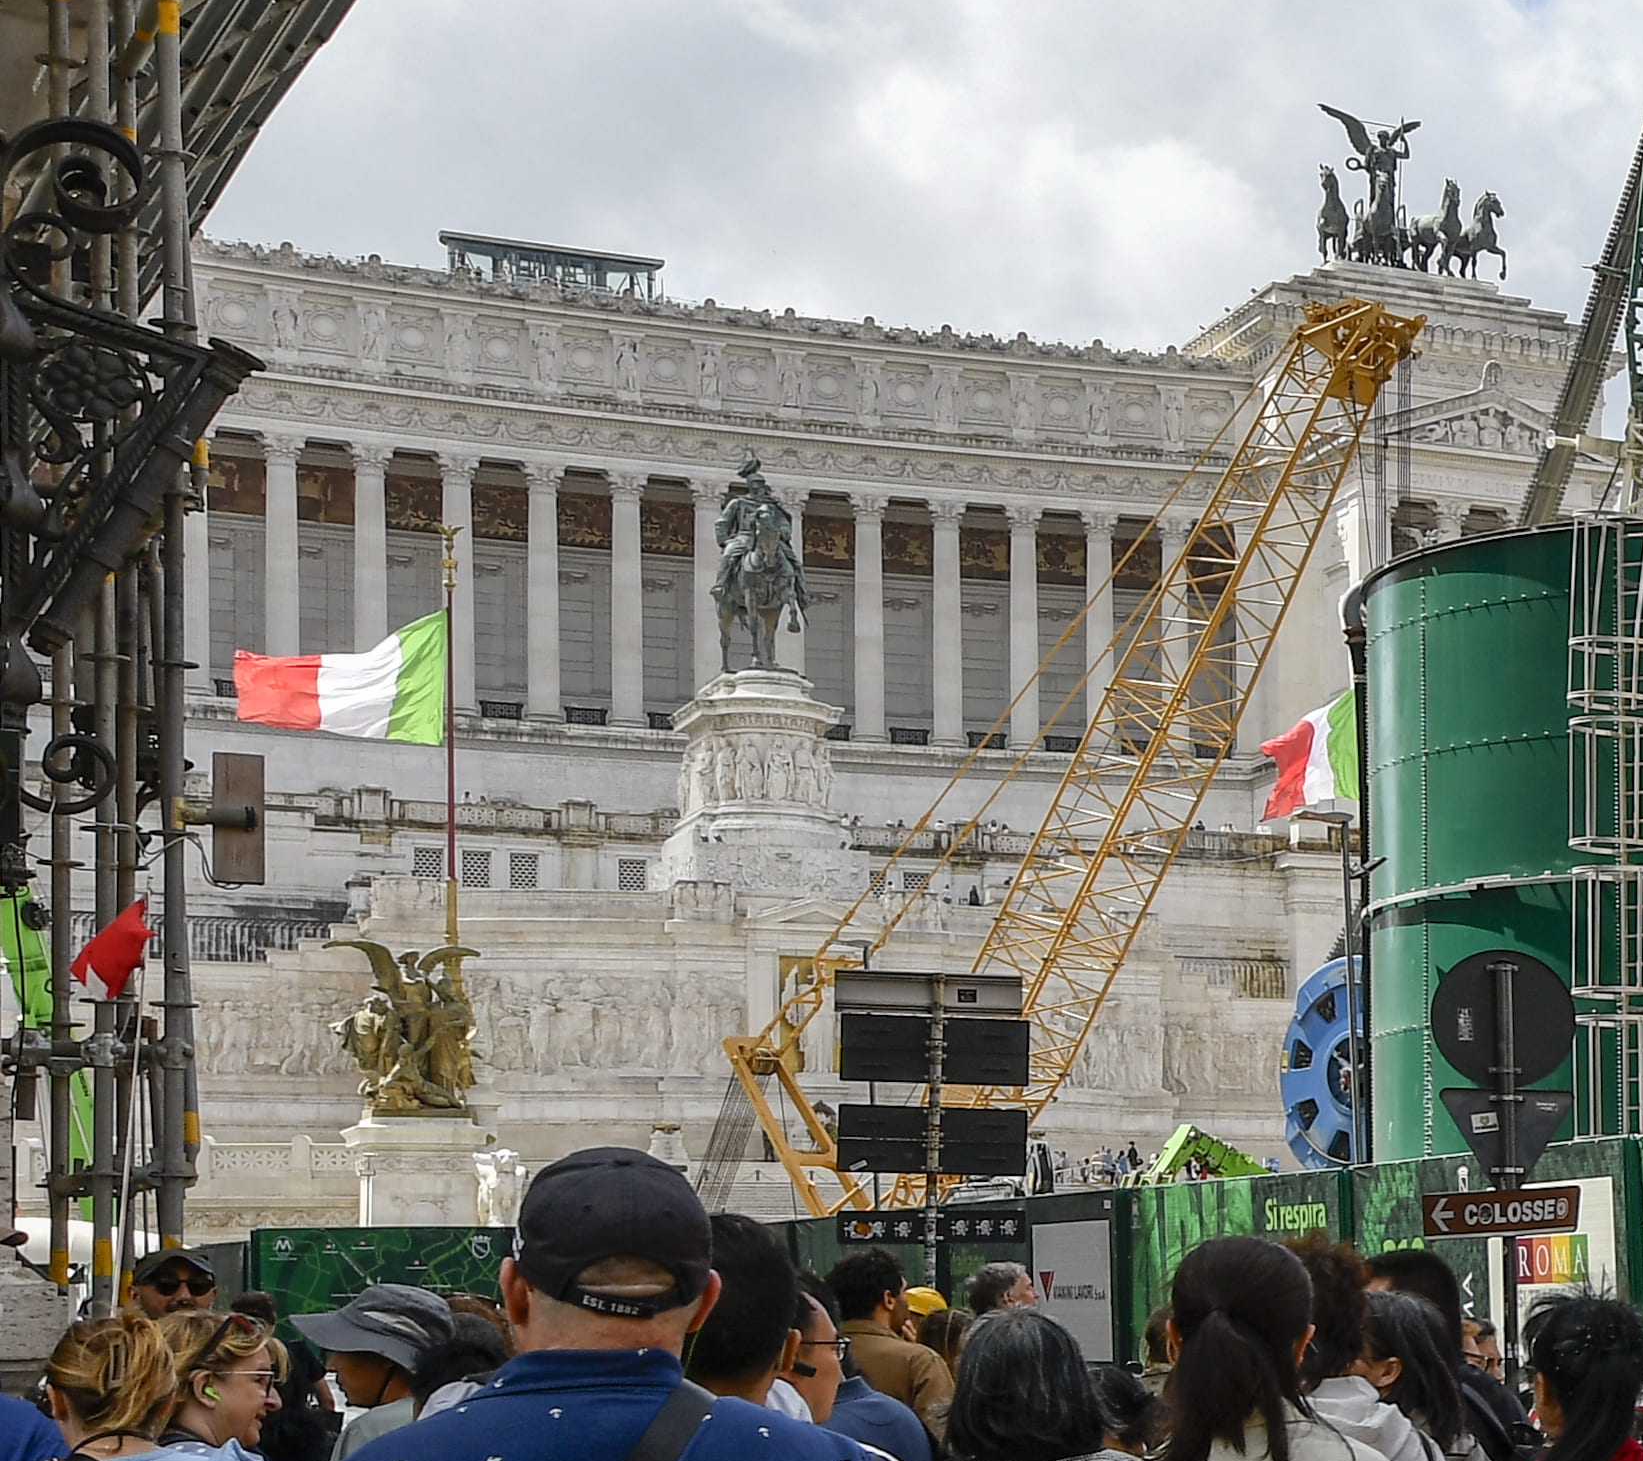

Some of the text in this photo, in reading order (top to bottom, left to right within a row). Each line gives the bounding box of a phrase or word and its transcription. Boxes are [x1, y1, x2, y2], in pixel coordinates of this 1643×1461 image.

[1265, 1195, 1327, 1236] Si respira
[1518, 1243, 1586, 1278] ROMA
